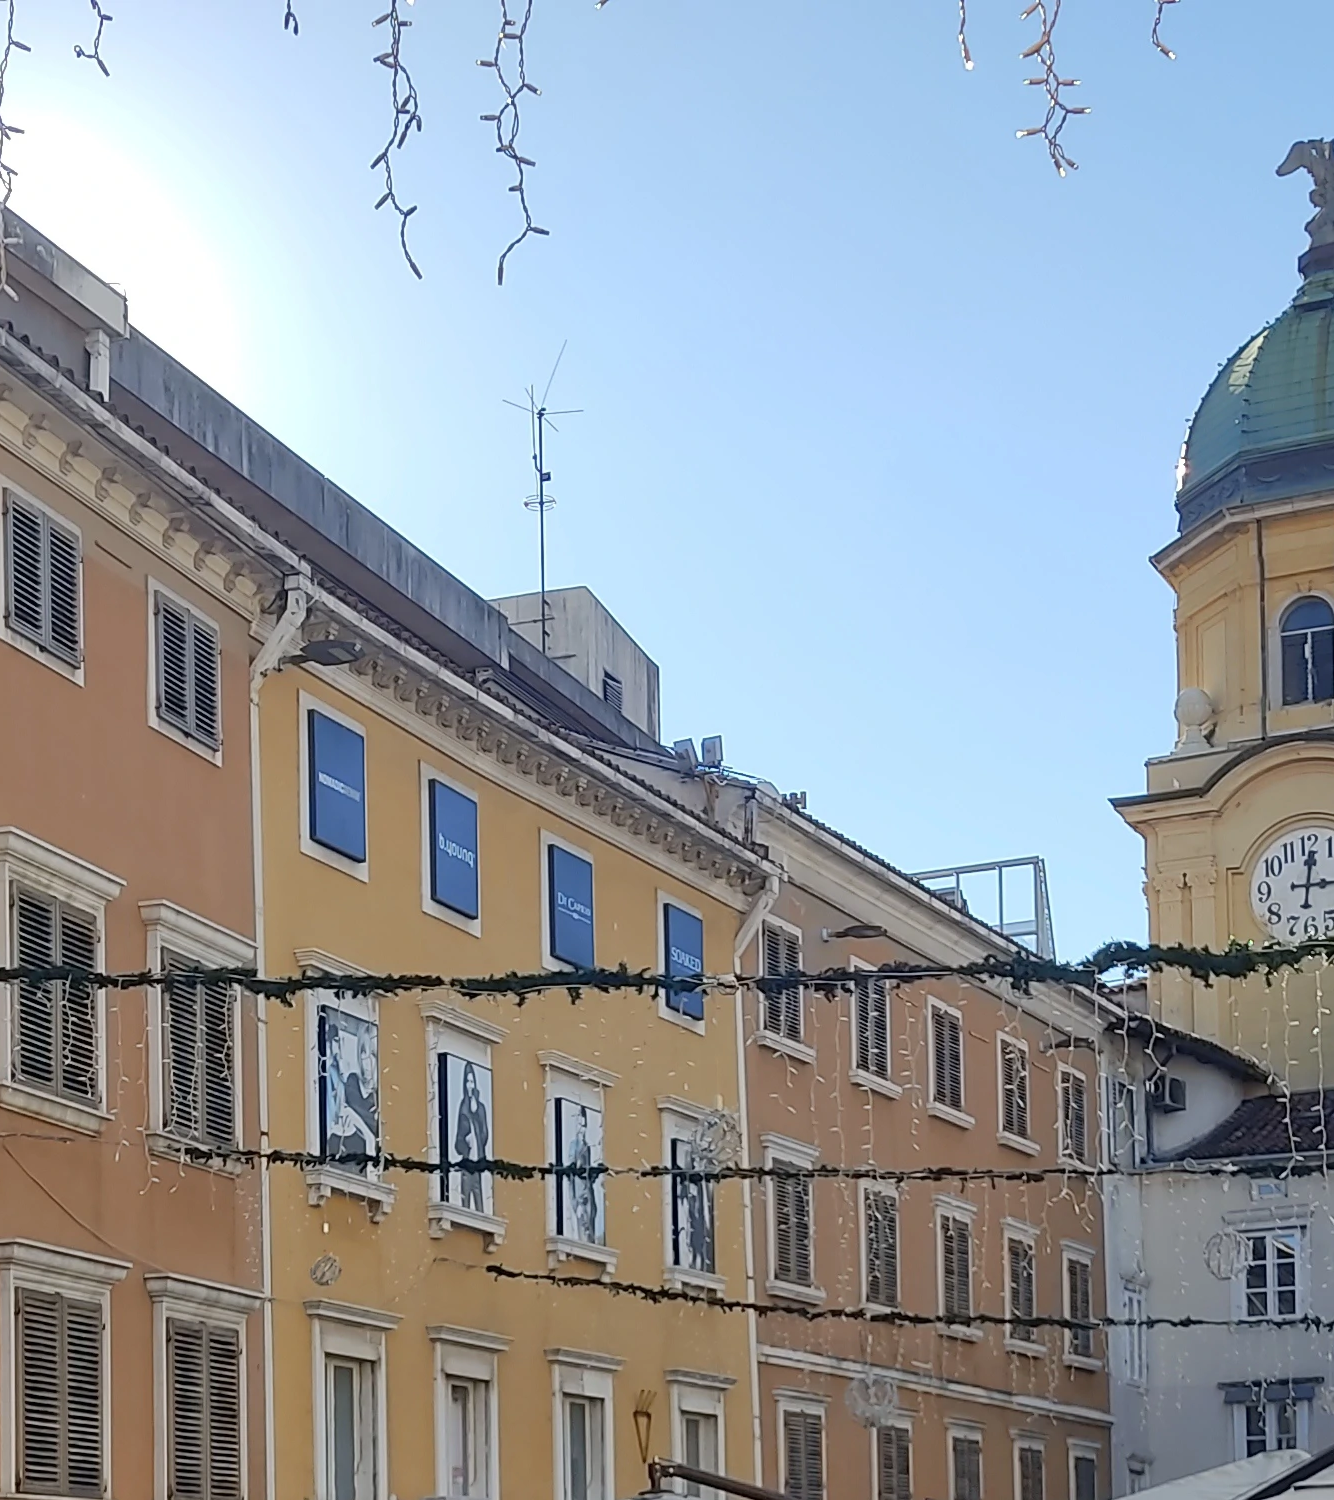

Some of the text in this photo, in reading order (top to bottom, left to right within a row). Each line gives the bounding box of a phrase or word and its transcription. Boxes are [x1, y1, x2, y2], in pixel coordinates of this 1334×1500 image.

[1280, 842, 1295, 863] 11
[1300, 834, 1318, 856] 12
[1326, 836, 1332, 858] 1
[1264, 856, 1282, 877] 10
[1258, 882, 1271, 903] 9
[1268, 902, 1281, 925] 8
[1286, 916, 1300, 936] 7
[1304, 916, 1318, 937] 6
[671, 946, 702, 972] SOAKED
